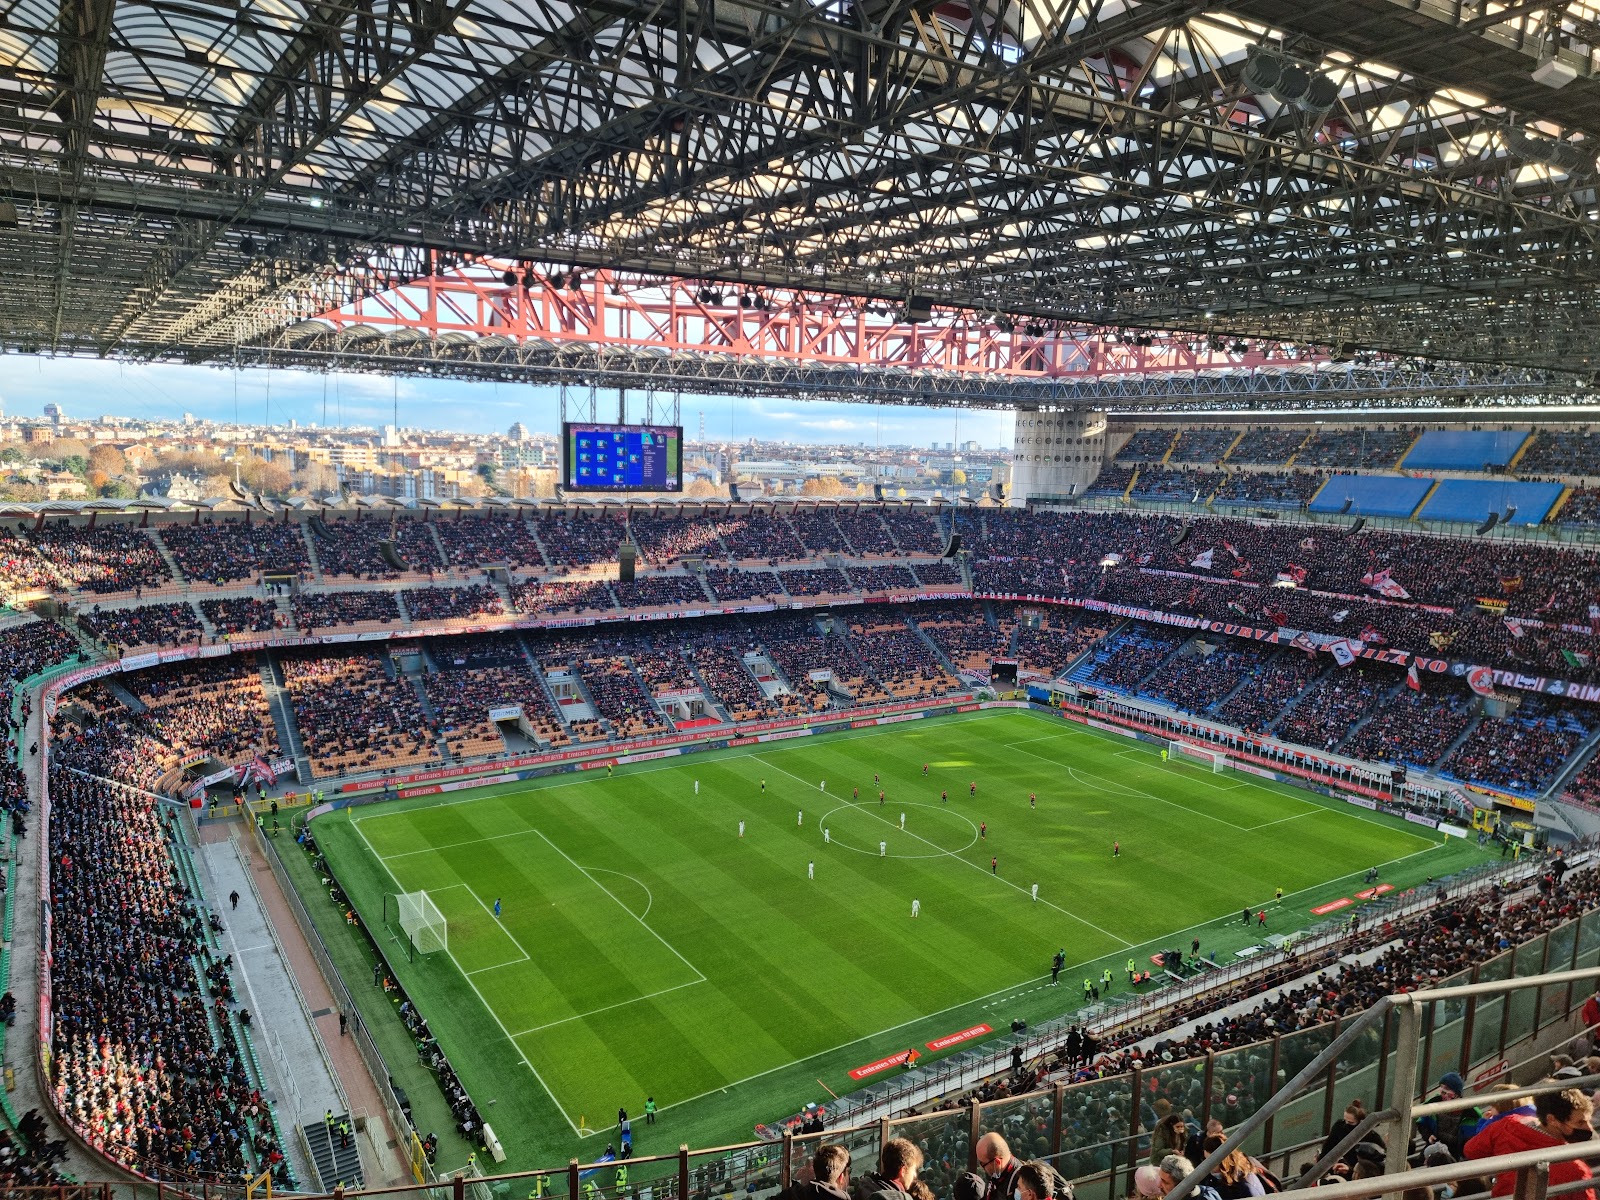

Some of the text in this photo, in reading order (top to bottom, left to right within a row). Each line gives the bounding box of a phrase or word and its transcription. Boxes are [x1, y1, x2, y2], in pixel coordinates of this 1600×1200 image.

[983, 592, 1085, 607] FOSSA DEI LEONI
[1210, 622, 1278, 643] CURVA
[79, 662, 122, 684] ROSSONERO
[520, 758, 543, 766] Emirates
[587, 760, 613, 769] Emirates
[1243, 753, 1265, 764] Emirates
[271, 760, 290, 770] SANO
[274, 764, 295, 776] CIANO
[468, 763, 493, 772] Emirates
[1287, 765, 1309, 777] Emirates
[414, 772, 441, 781] Emirates
[404, 787, 436, 798] Emirates
[1403, 782, 1442, 799] ADERNO
[933, 1035, 963, 1048] Emirates
[856, 1061, 889, 1076] Emirates
